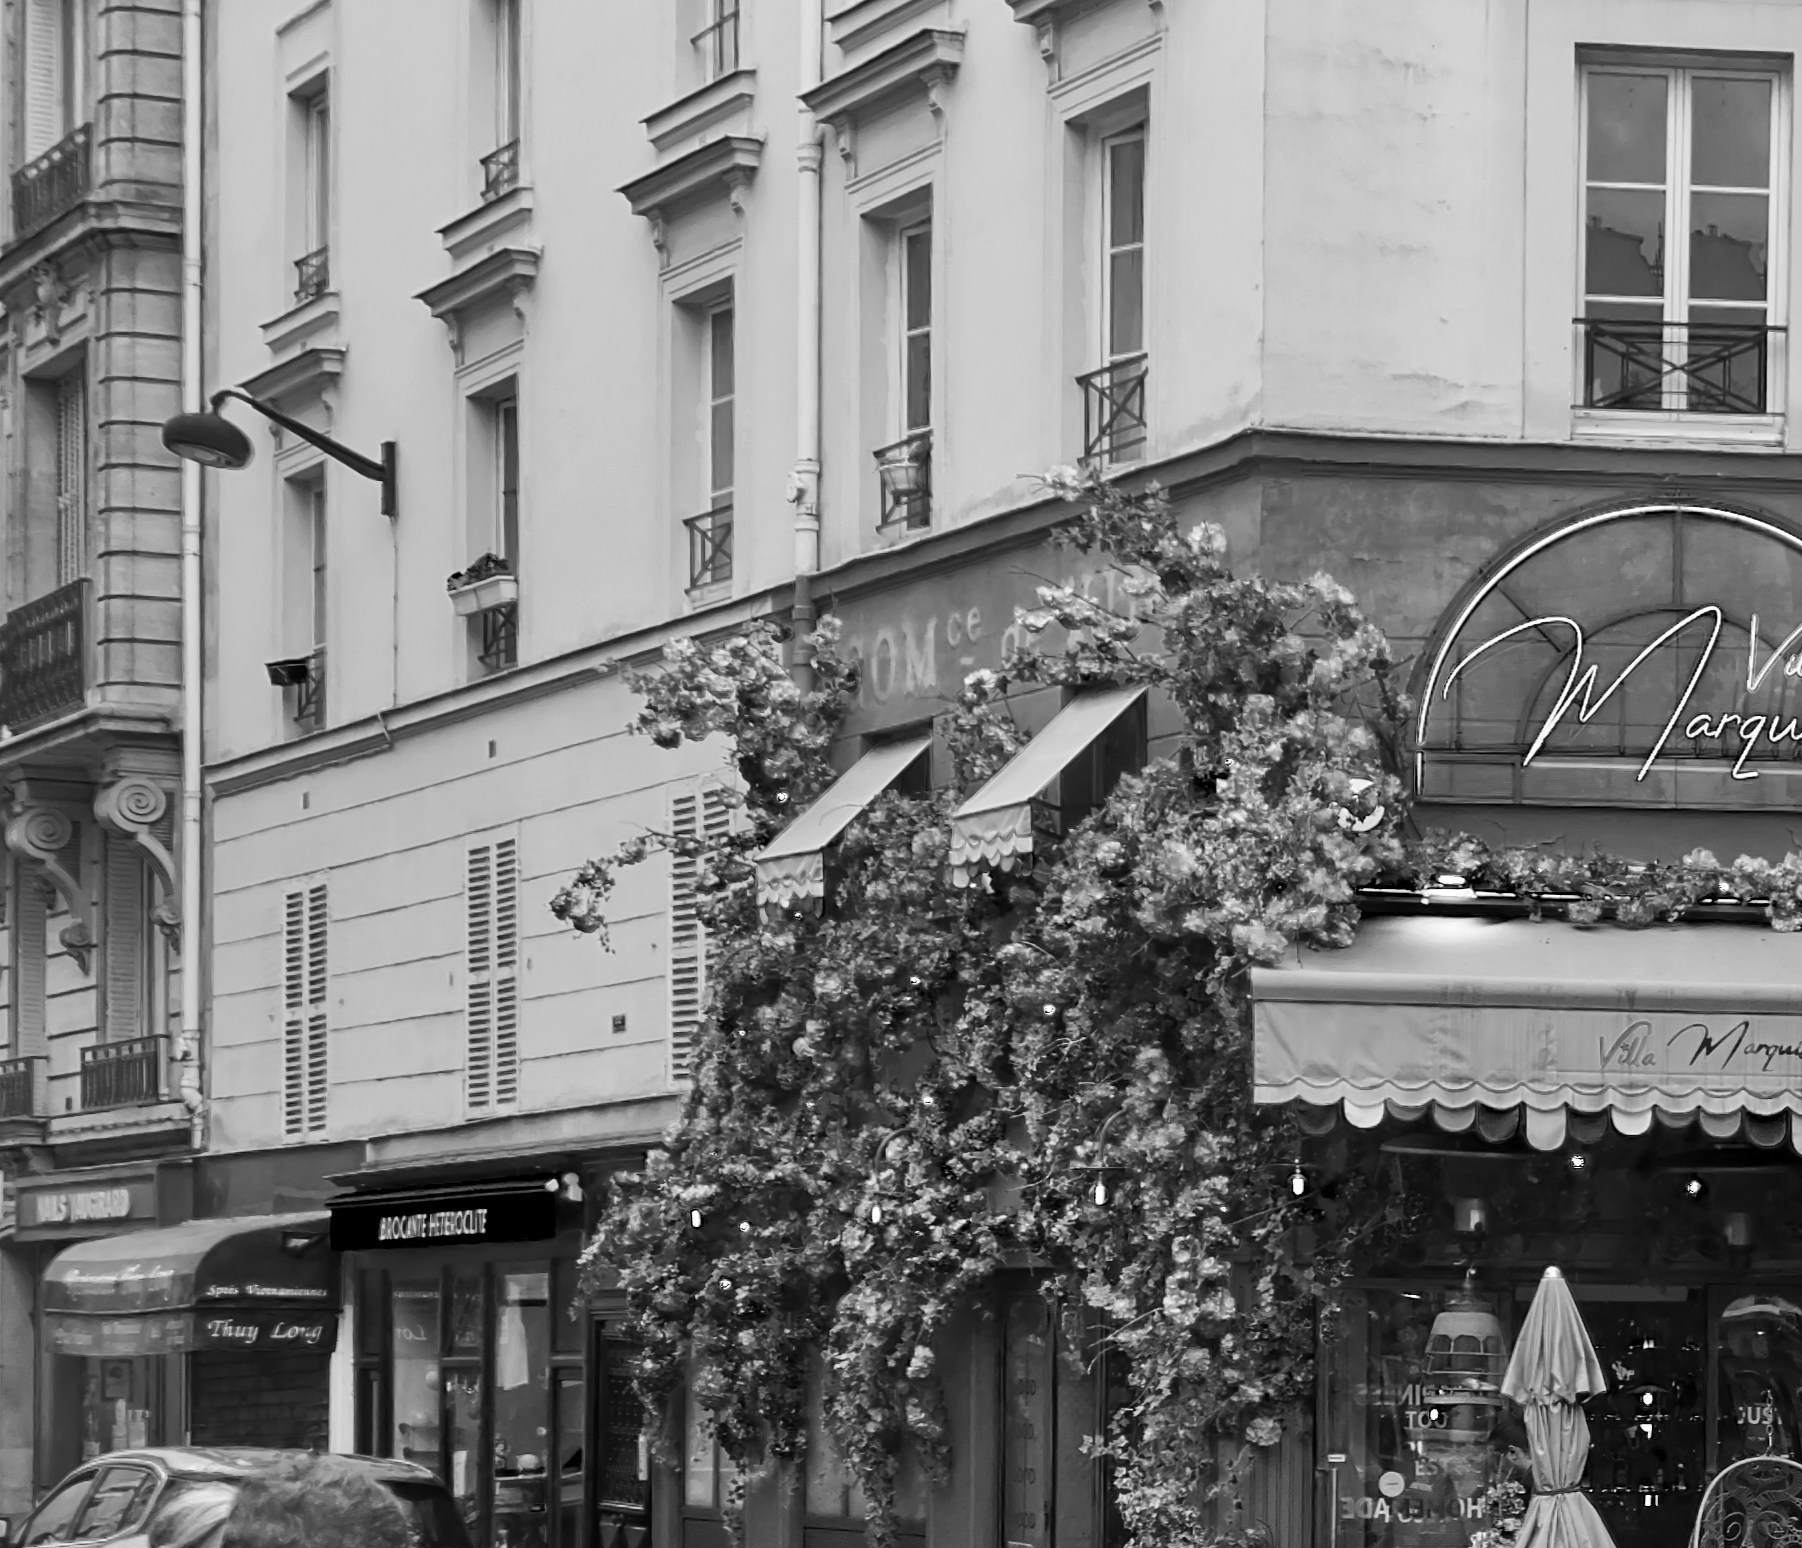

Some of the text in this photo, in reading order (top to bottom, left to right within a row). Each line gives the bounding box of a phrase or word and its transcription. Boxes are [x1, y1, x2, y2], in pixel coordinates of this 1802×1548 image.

[1599, 1020, 1657, 1069] Villa
[378, 1212, 428, 1241] BROCANTE
[207, 1318, 260, 1344] Thuy
[269, 1321, 324, 1344] Long
